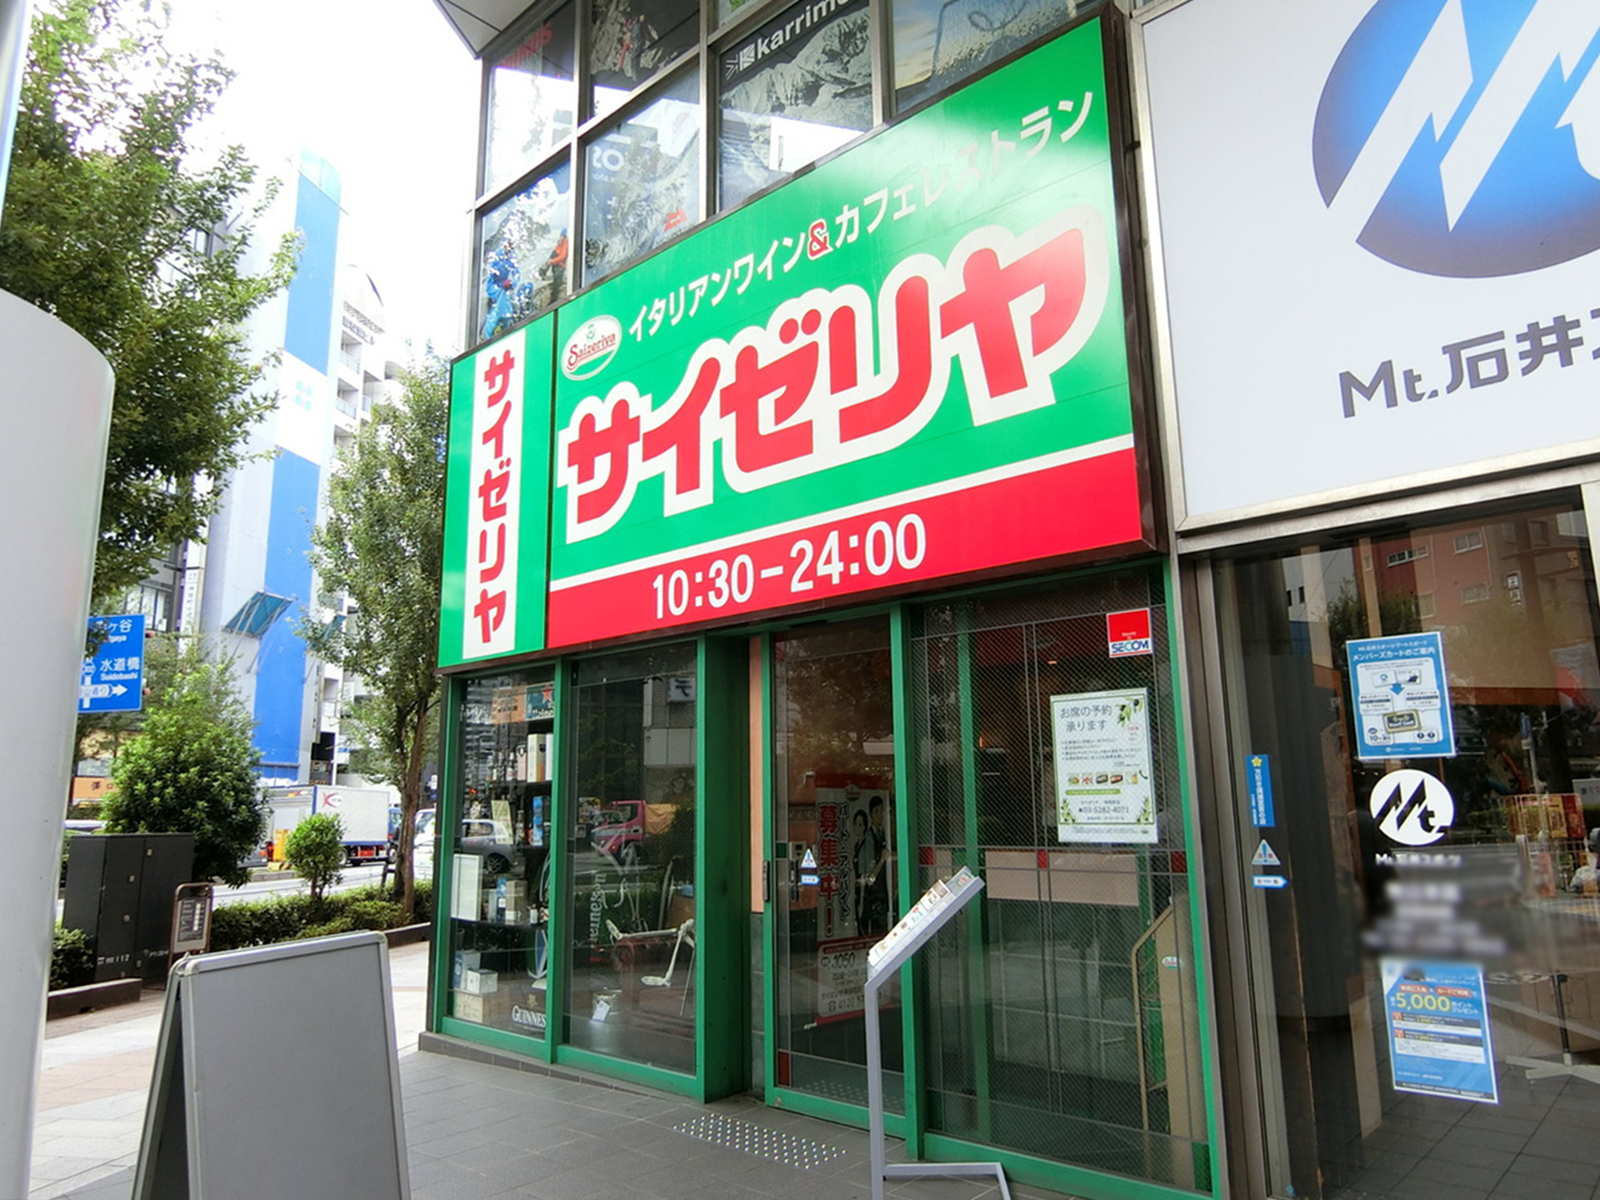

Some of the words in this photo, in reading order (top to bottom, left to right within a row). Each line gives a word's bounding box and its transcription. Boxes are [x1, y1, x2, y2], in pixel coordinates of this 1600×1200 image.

[757, 0, 850, 59] karrim
[566, 333, 617, 371] Saizeriya
[1339, 308, 1600, 419] Mt.石井
[557, 205, 1110, 543] サイゼリヤ
[474, 349, 515, 644] サイゼリヤ
[1111, 640, 1149, 653] SECOM
[1352, 646, 1436, 662] メンバーズカードのご案内
[100, 657, 140, 671] 水道橋
[1060, 704, 1112, 718] お席の予約
[1066, 720, 1107, 733] 承ります
[1395, 992, 1451, 1012] 5,000
